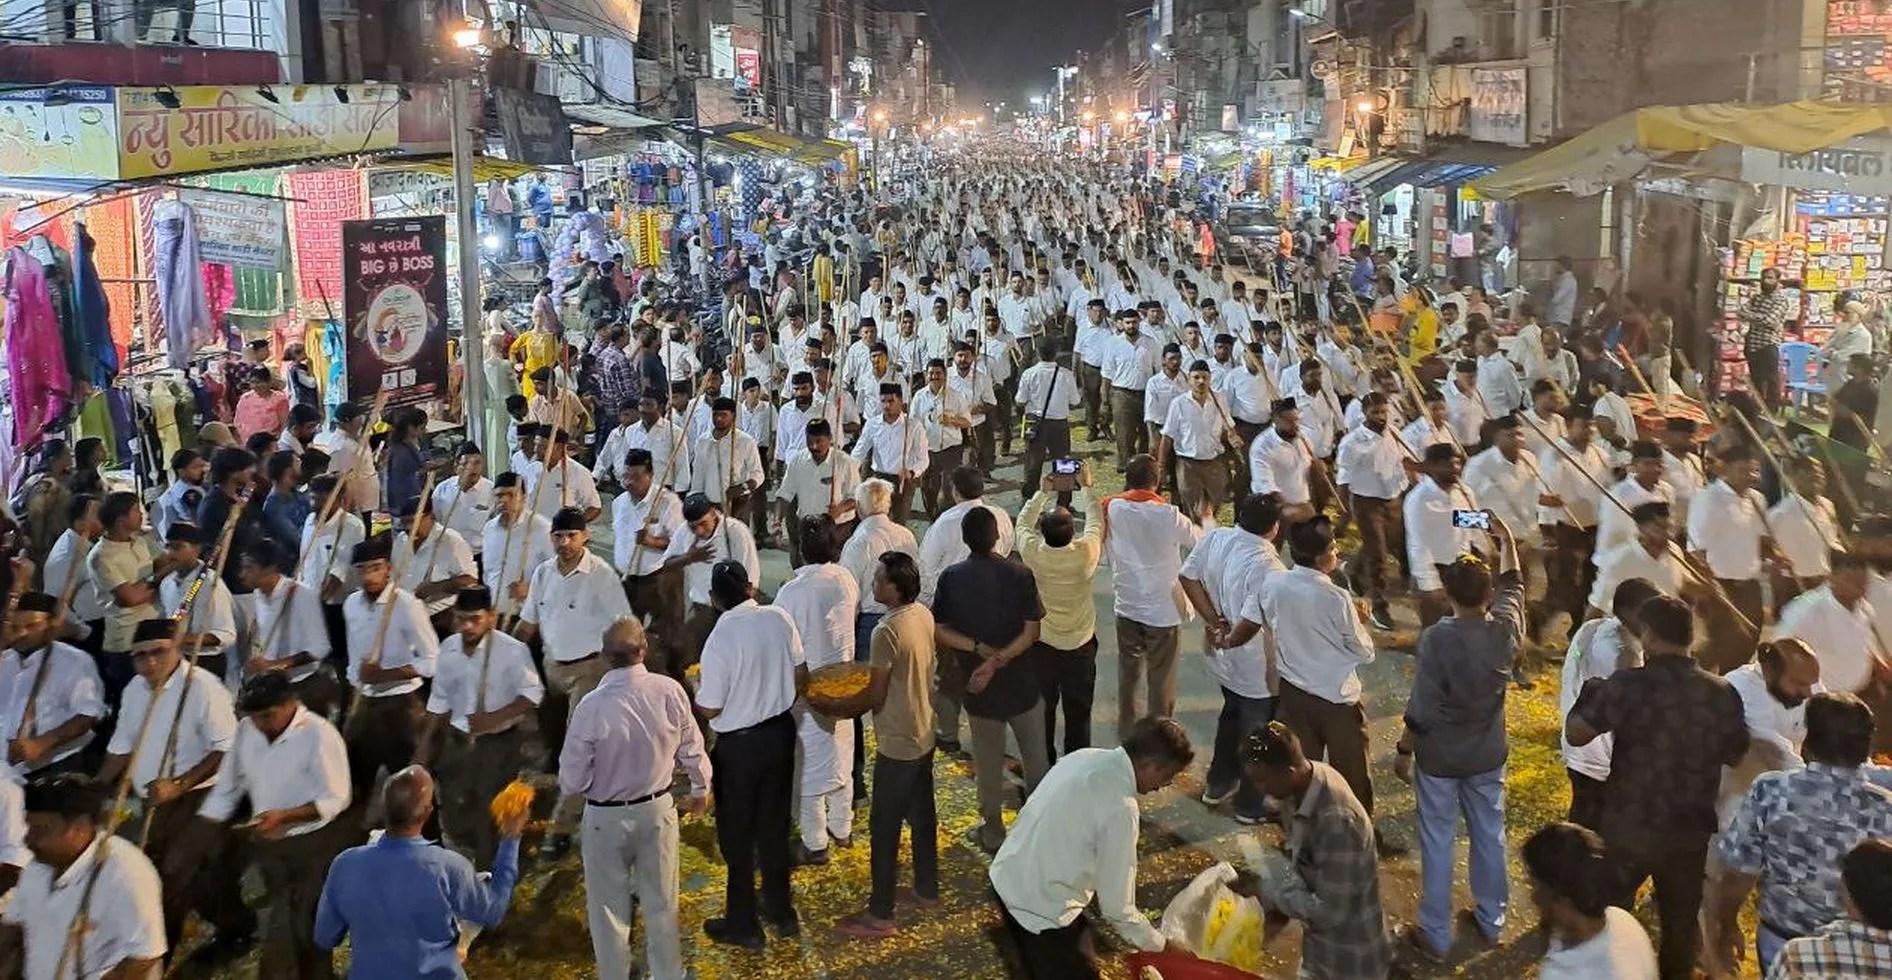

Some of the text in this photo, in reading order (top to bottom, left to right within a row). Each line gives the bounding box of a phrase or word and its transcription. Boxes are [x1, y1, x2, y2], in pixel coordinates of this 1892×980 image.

[179, 90, 277, 148] सारिका
[360, 259, 385, 275] BIG
[402, 254, 435, 272] BOSS
